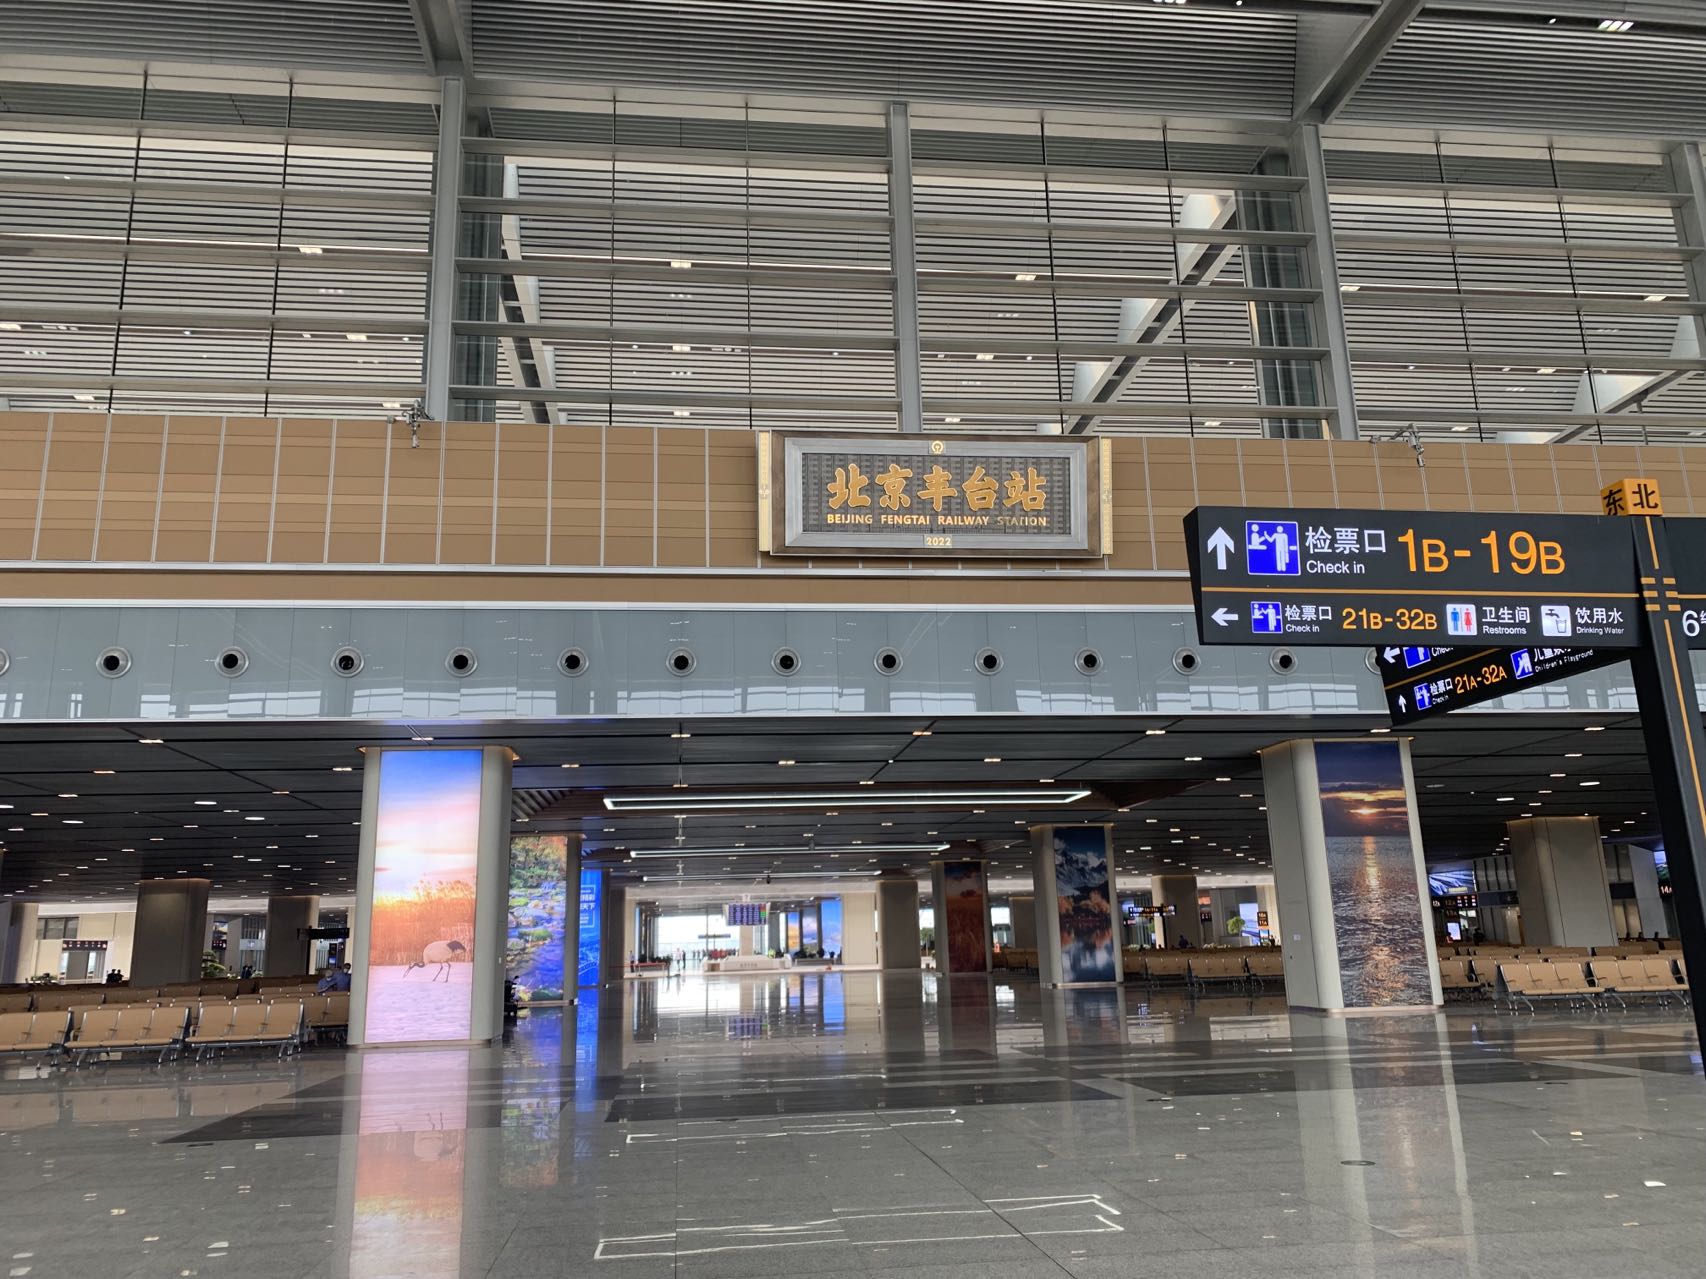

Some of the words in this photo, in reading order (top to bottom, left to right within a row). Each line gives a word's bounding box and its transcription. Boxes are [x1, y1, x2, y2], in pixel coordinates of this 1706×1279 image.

[827, 463, 1047, 511] 北京丰台站
[1632, 483, 1659, 509] 北
[1603, 487, 1625, 515] 东
[827, 514, 873, 524] BEIJING
[881, 515, 930, 525] FENGTAI
[938, 515, 989, 526] RAILWAY
[997, 516, 1047, 526] STATION
[926, 536, 951, 546] 2022
[1305, 526, 1387, 554] 检票口
[1398, 528, 1566, 575] 1B-19B
[1306, 560, 1350, 574] Check
[1353, 560, 1365, 574] in
[1285, 604, 1332, 622] 检票口
[1342, 608, 1438, 630] 21B-32B
[1482, 606, 1531, 624] 卫生间
[1575, 607, 1624, 625] 饮用水
[1285, 624, 1311, 633] Check
[1312, 624, 1320, 633] in
[1483, 625, 1527, 635] Restrooms
[1576, 626, 1603, 636] Drinking
[1604, 626, 1625, 635] Water
[1535, 660, 1563, 673] Children's
[1563, 649, 1594, 664] Playground
[1430, 678, 1453, 696] 检票口
[1454, 664, 1508, 694] 21A-32A
